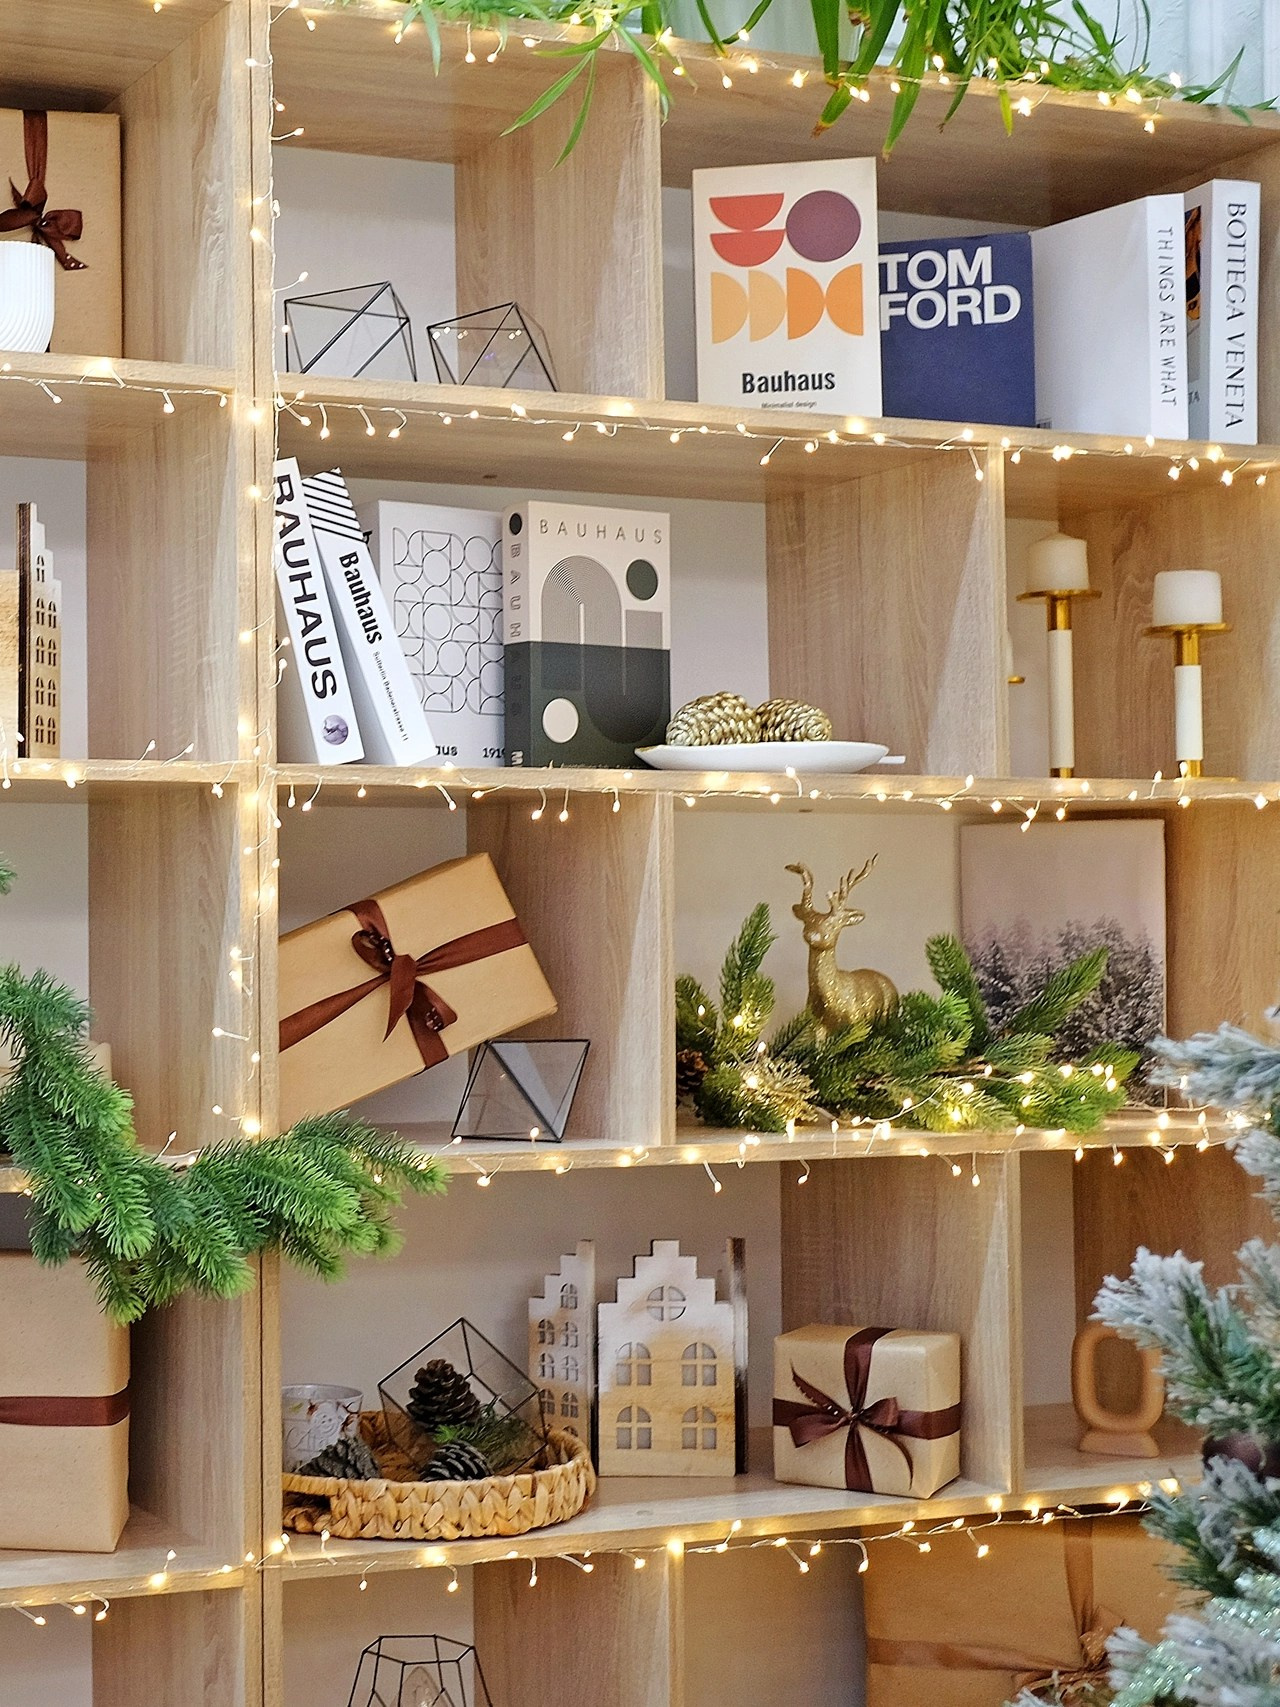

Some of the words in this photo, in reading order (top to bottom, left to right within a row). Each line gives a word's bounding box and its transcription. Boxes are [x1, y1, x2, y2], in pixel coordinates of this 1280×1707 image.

[878, 246, 992, 292] TOM
[1157, 226, 1175, 303] THINGS
[1225, 202, 1248, 322] BOTTEGA
[879, 284, 1022, 332] FORD
[1159, 310, 1176, 348] ARE
[742, 370, 835, 393] Bauhaus
[1160, 355, 1177, 406] WHAT
[1224, 332, 1247, 429] VENETA
[539, 519, 663, 544] BAUHAUS
[275, 473, 338, 700] BAUHAUS
[339, 551, 382, 645] Bauhaus
[483, 747, 505, 759] 191
